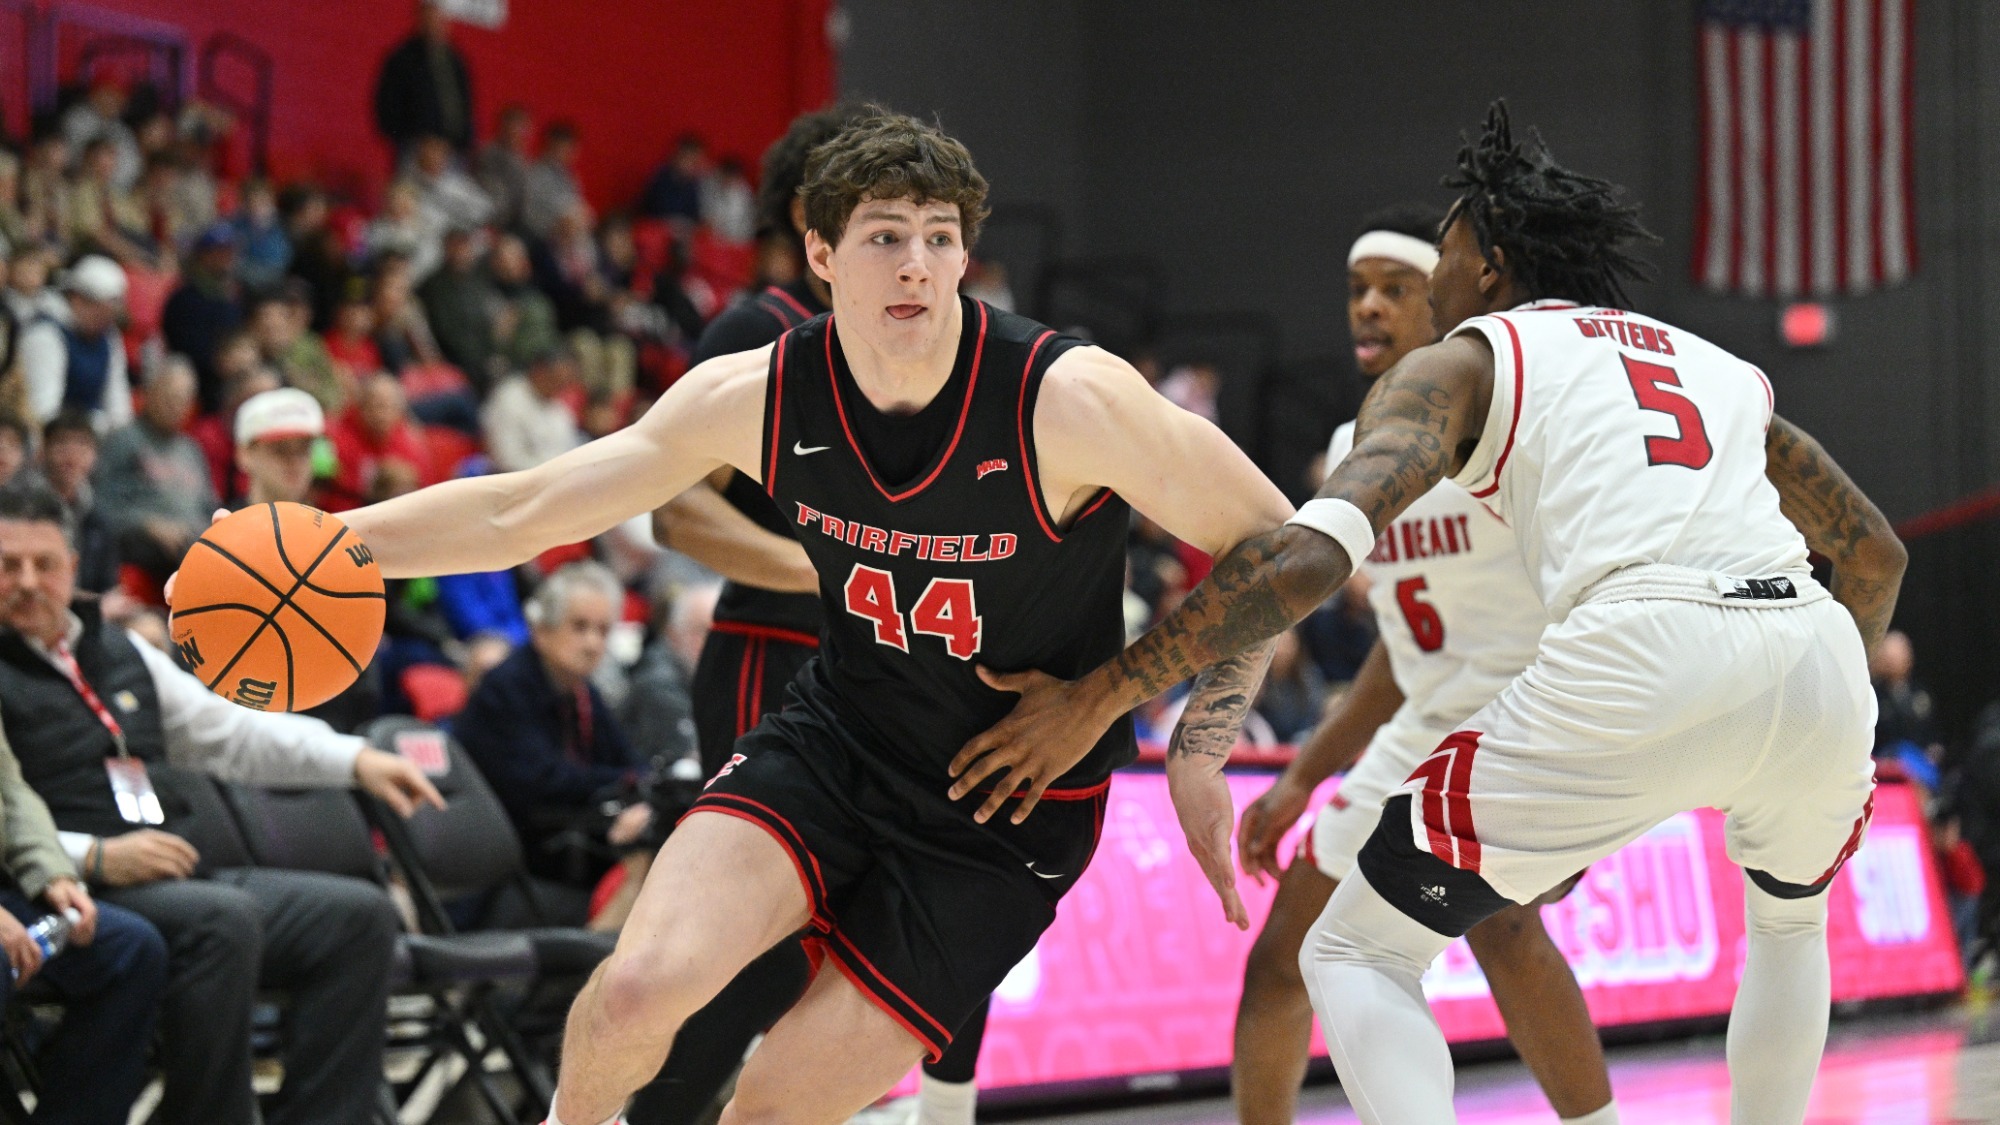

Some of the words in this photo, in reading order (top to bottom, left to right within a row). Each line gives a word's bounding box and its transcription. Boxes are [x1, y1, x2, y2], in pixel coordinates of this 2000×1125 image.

[1618, 350, 1714, 471] 5
[976, 458, 1009, 481] MAAC
[794, 500, 1018, 562] FAIRFIELD
[843, 562, 983, 661] 44
[1396, 575, 1446, 653] 6
